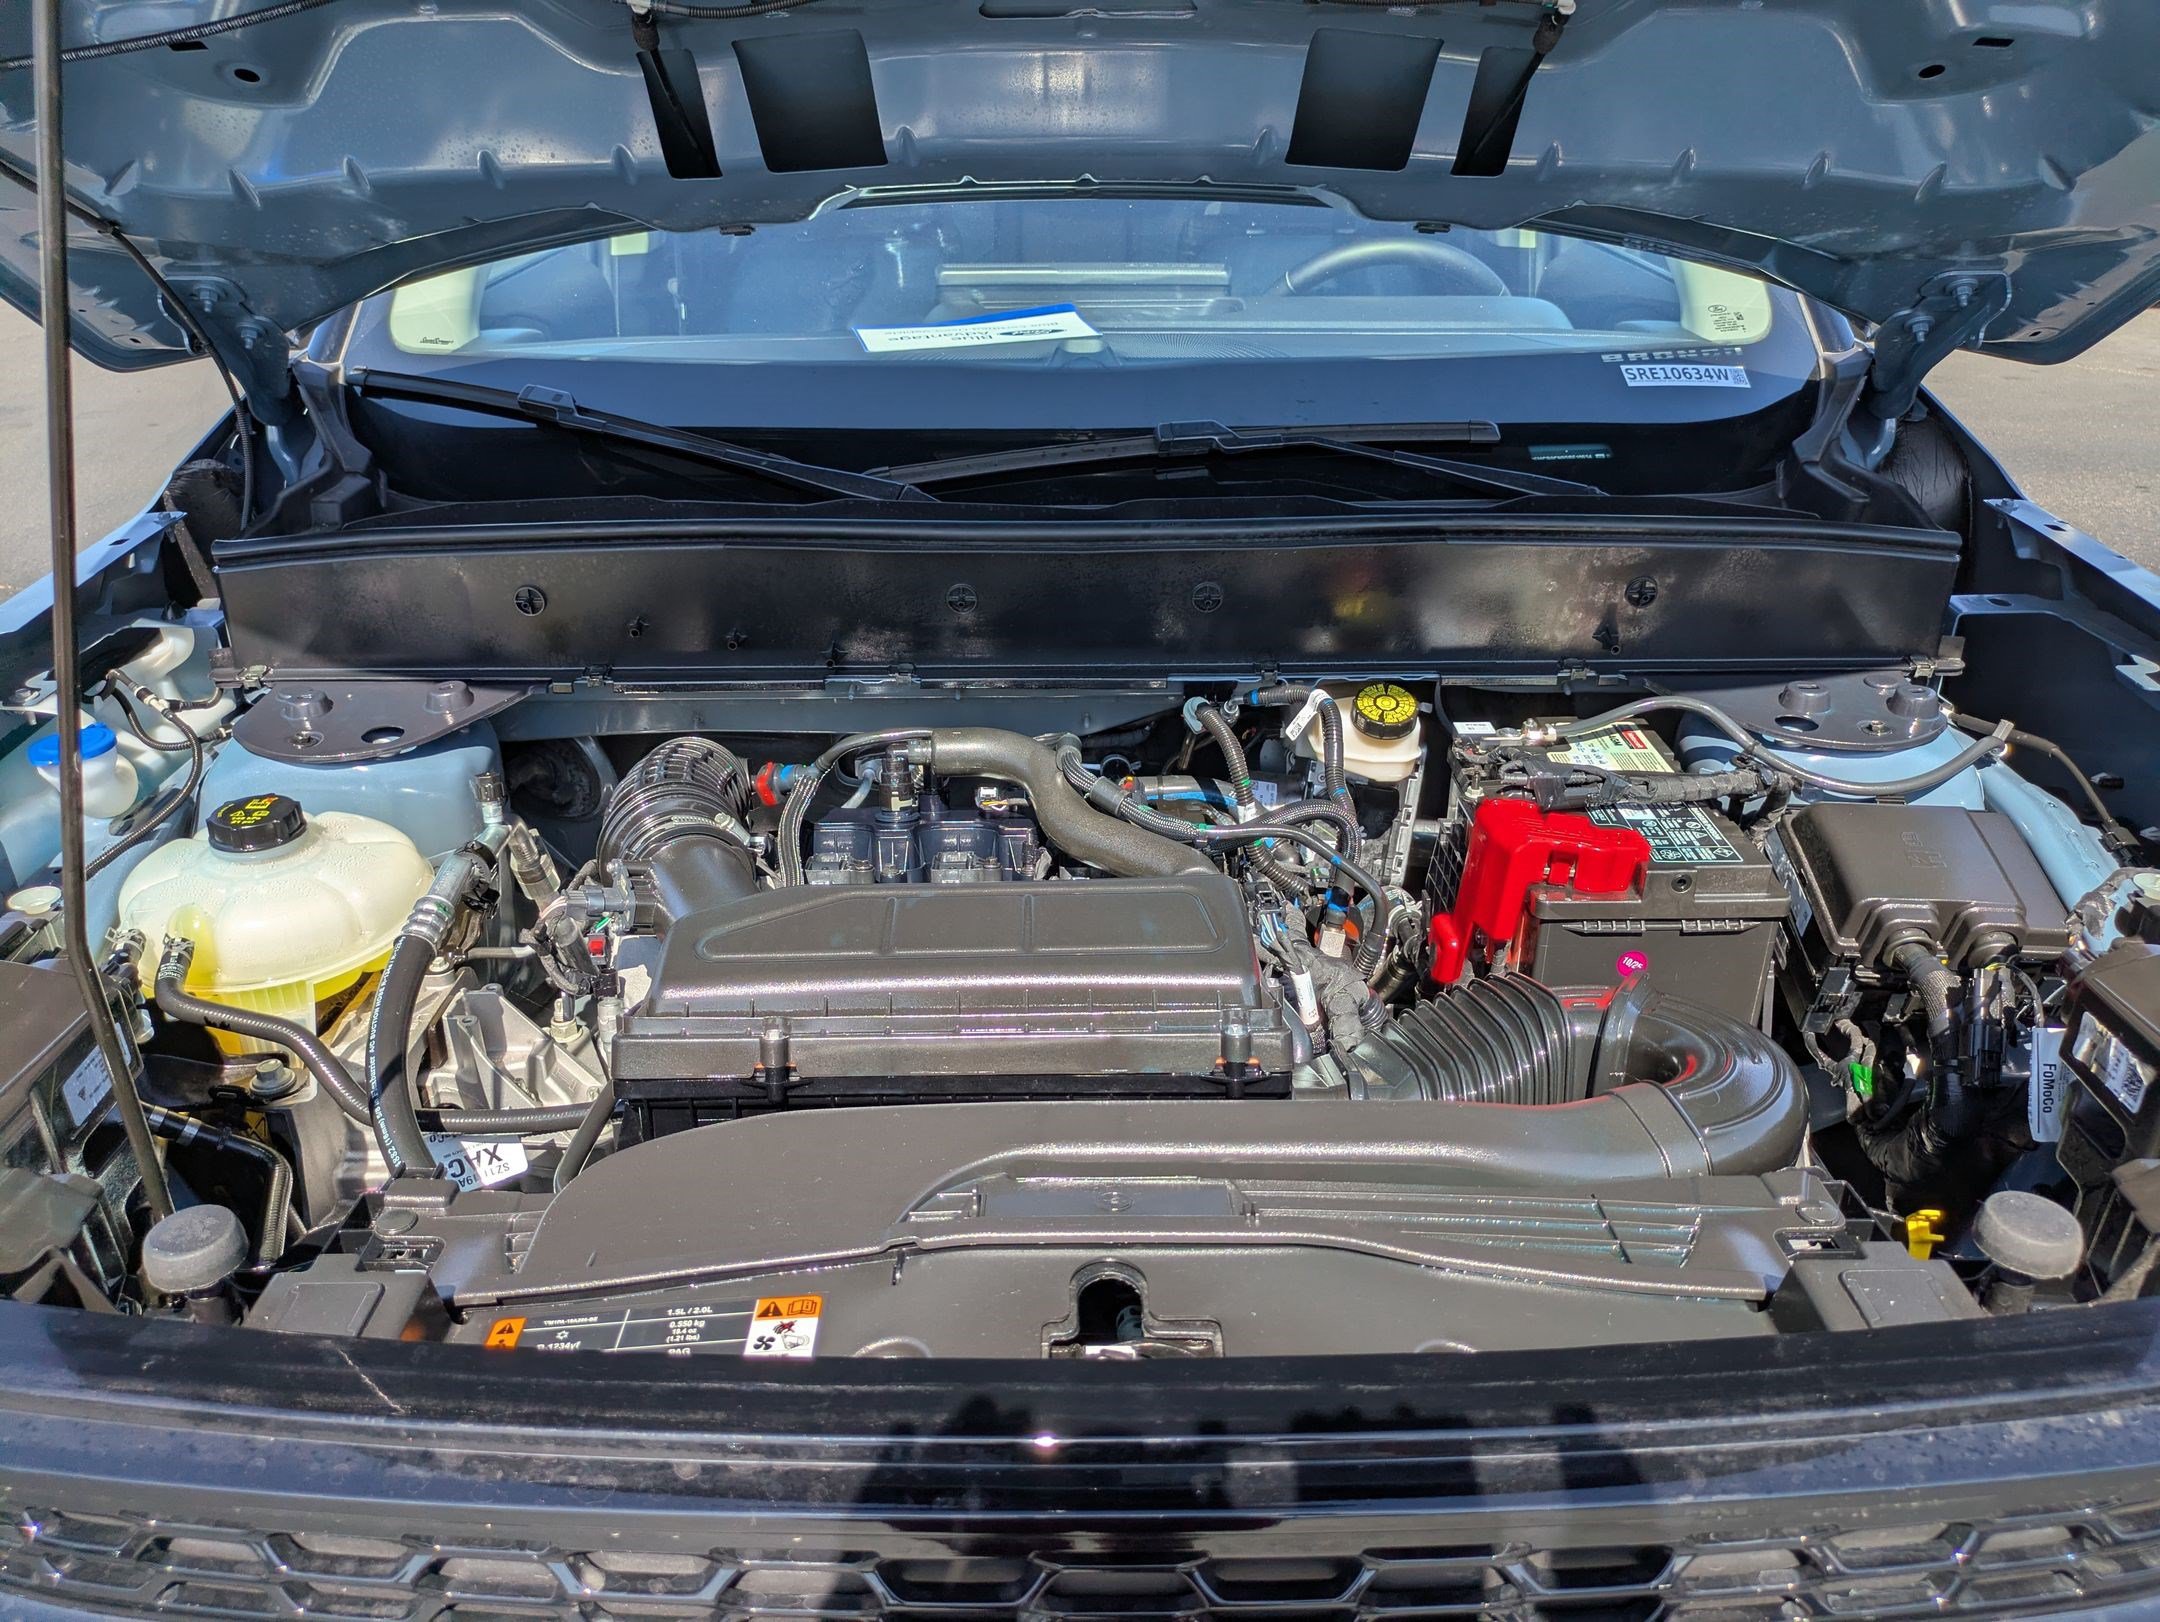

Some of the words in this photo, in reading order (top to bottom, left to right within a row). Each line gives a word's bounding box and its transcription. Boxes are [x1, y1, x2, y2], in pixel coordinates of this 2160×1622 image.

[1624, 367, 1729, 381] SRE10634W
[369, 1007, 380, 1040] SUCTION
[2042, 1063, 2057, 1113] FoMoCo
[667, 1308, 687, 1316] 1.5L
[693, 1306, 713, 1314] 2.0L
[669, 1320, 693, 1329] 0.550
[693, 1319, 706, 1329] kg
